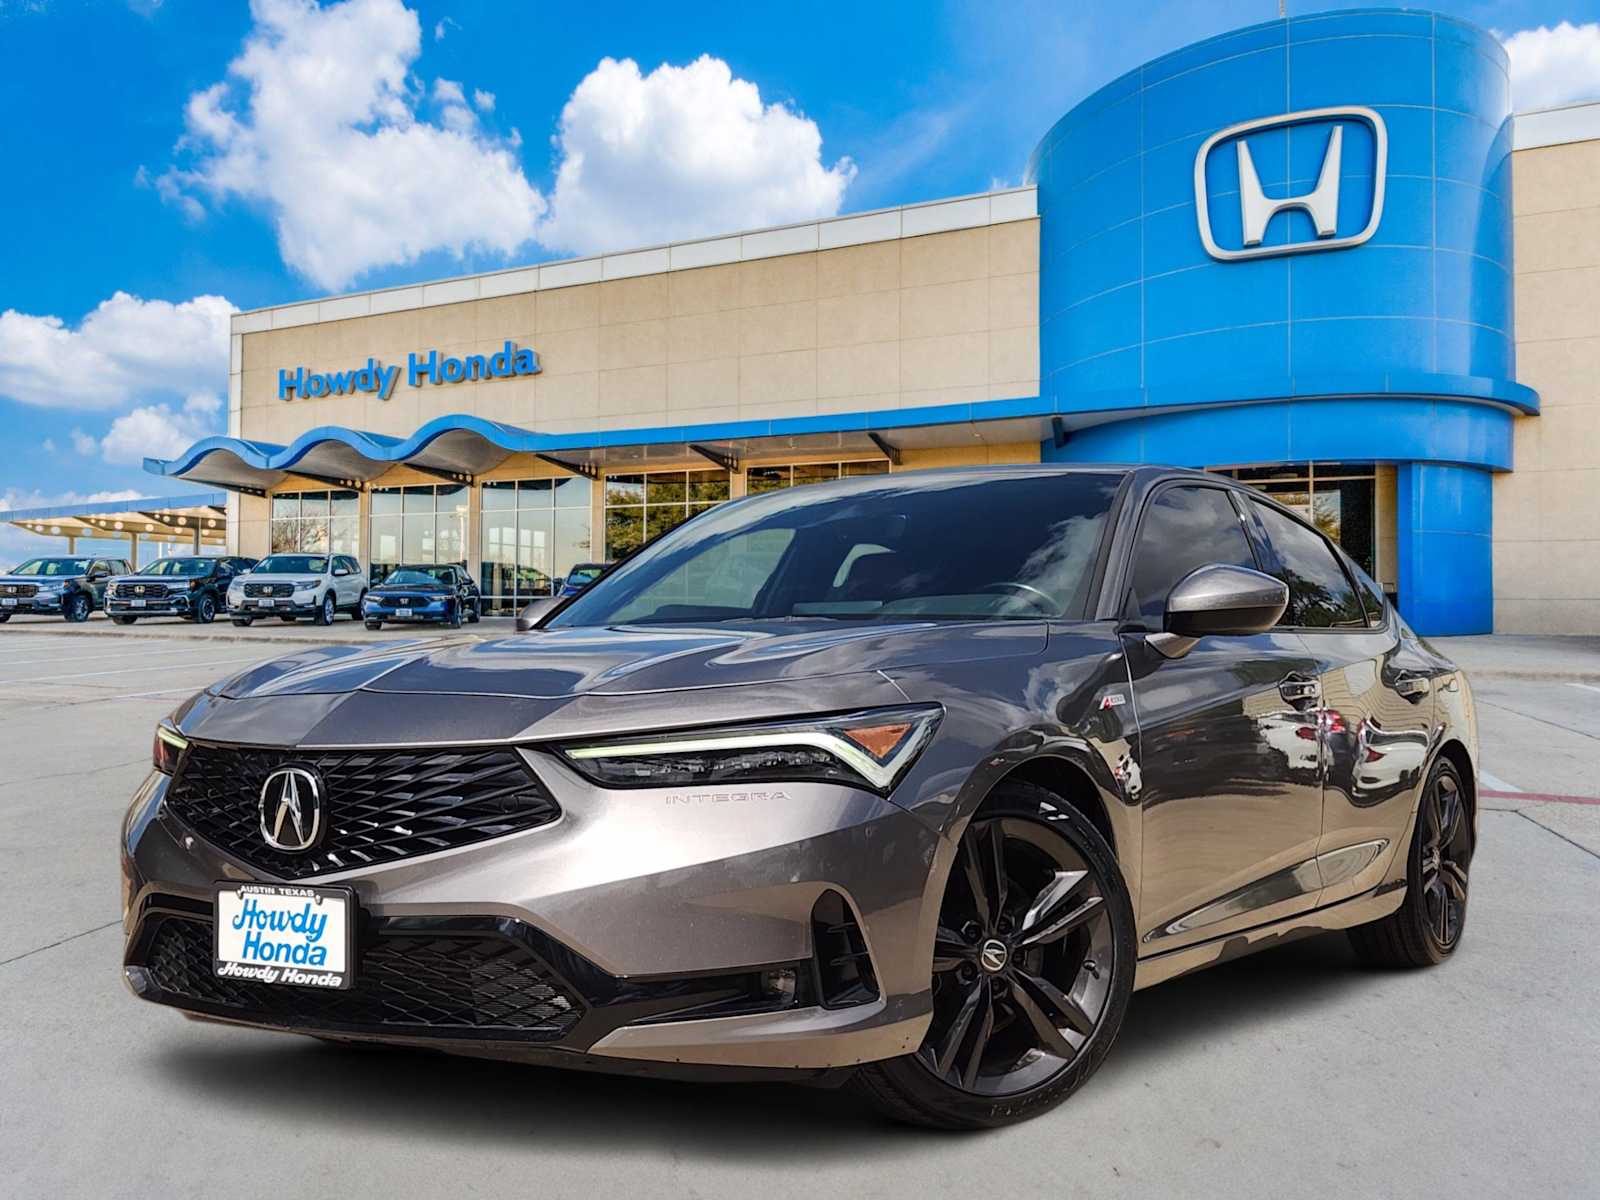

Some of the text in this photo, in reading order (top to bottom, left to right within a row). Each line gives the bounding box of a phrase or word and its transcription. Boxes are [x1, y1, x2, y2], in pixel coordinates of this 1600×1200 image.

[278, 340, 543, 401] Howdy Honda
[665, 791, 792, 805] INTEGRA
[239, 885, 315, 897] AUSTIN TEXAS
[232, 898, 328, 943] Howdy
[242, 930, 328, 966] Honda
[217, 962, 343, 988] Howdy Honda
